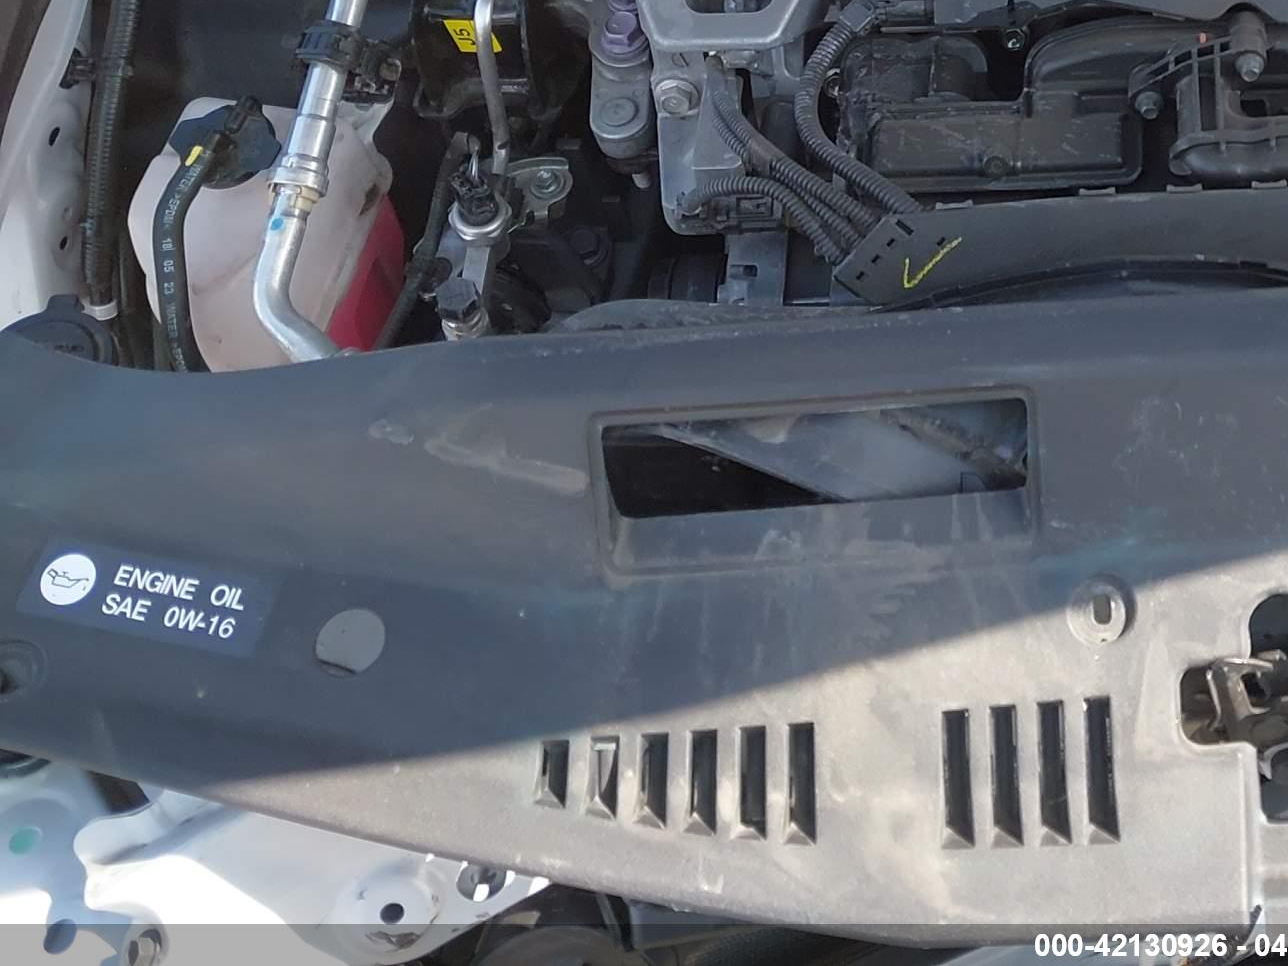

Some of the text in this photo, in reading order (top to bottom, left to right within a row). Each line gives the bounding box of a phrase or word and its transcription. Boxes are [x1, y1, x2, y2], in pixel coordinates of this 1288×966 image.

[453, 28, 476, 45] J5
[114, 564, 244, 611] ENGINE OIL
[102, 594, 236, 639] SAE 0W-16
